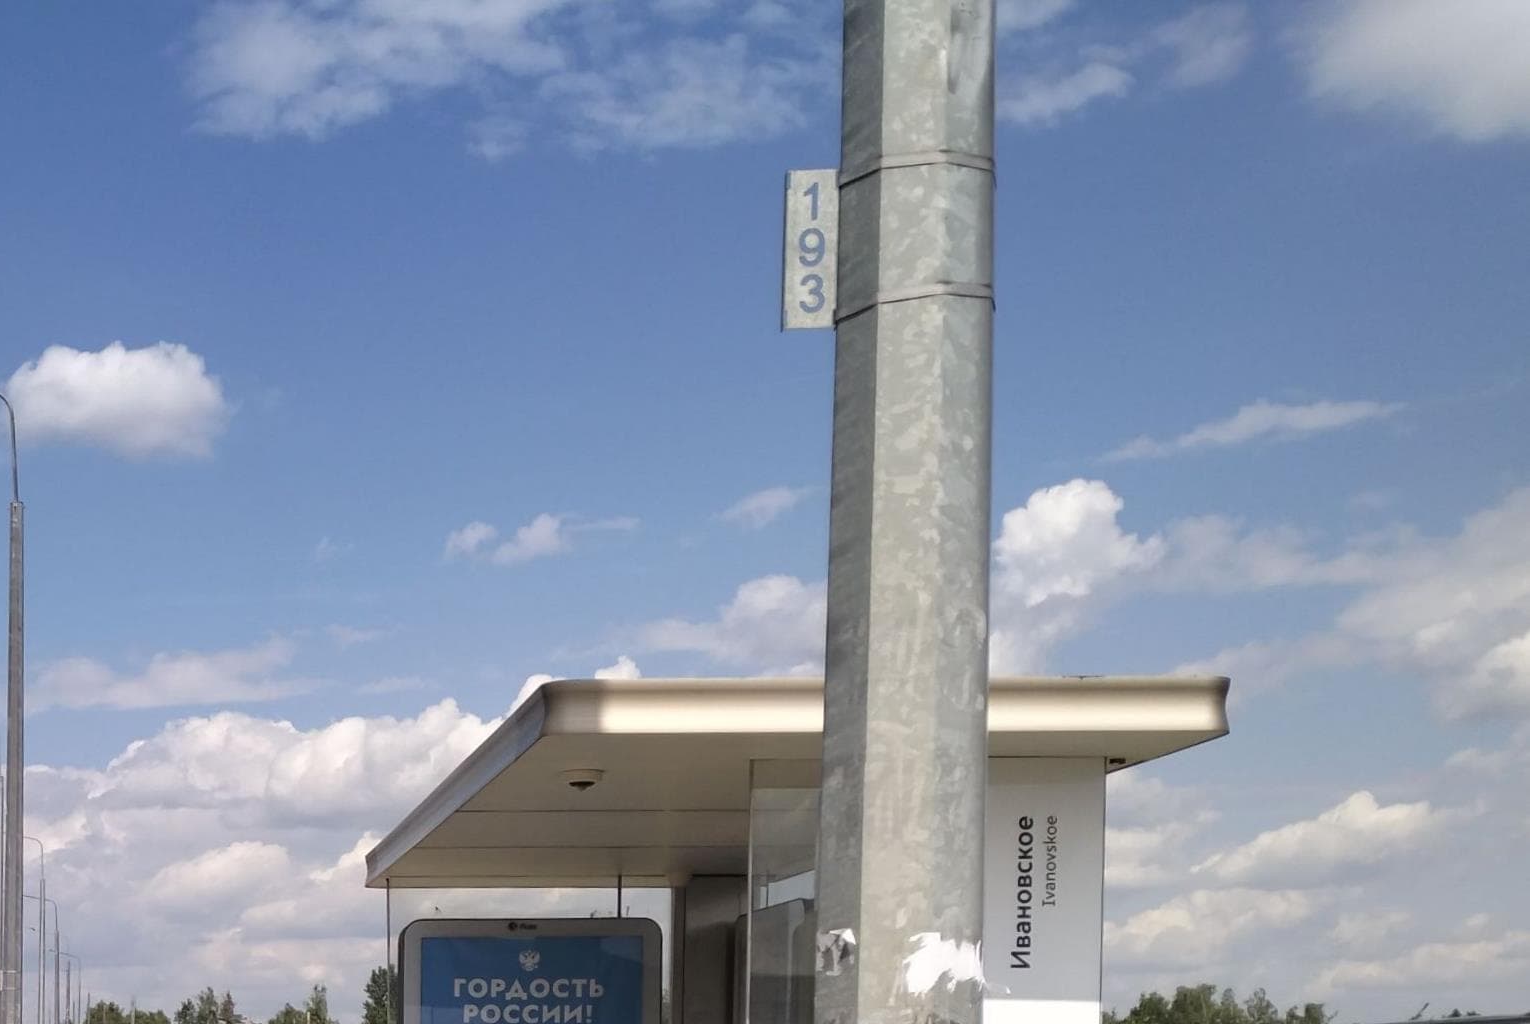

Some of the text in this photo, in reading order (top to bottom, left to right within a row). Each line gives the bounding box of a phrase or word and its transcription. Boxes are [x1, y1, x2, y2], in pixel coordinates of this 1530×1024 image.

[797, 181, 827, 315] 193
[1010, 815, 1035, 969] Ивановское
[1041, 814, 1058, 907] Ivanovskoe
[453, 977, 605, 1001] ГОРДОСТЬ
[462, 1003, 594, 1024] РОССИИ!
